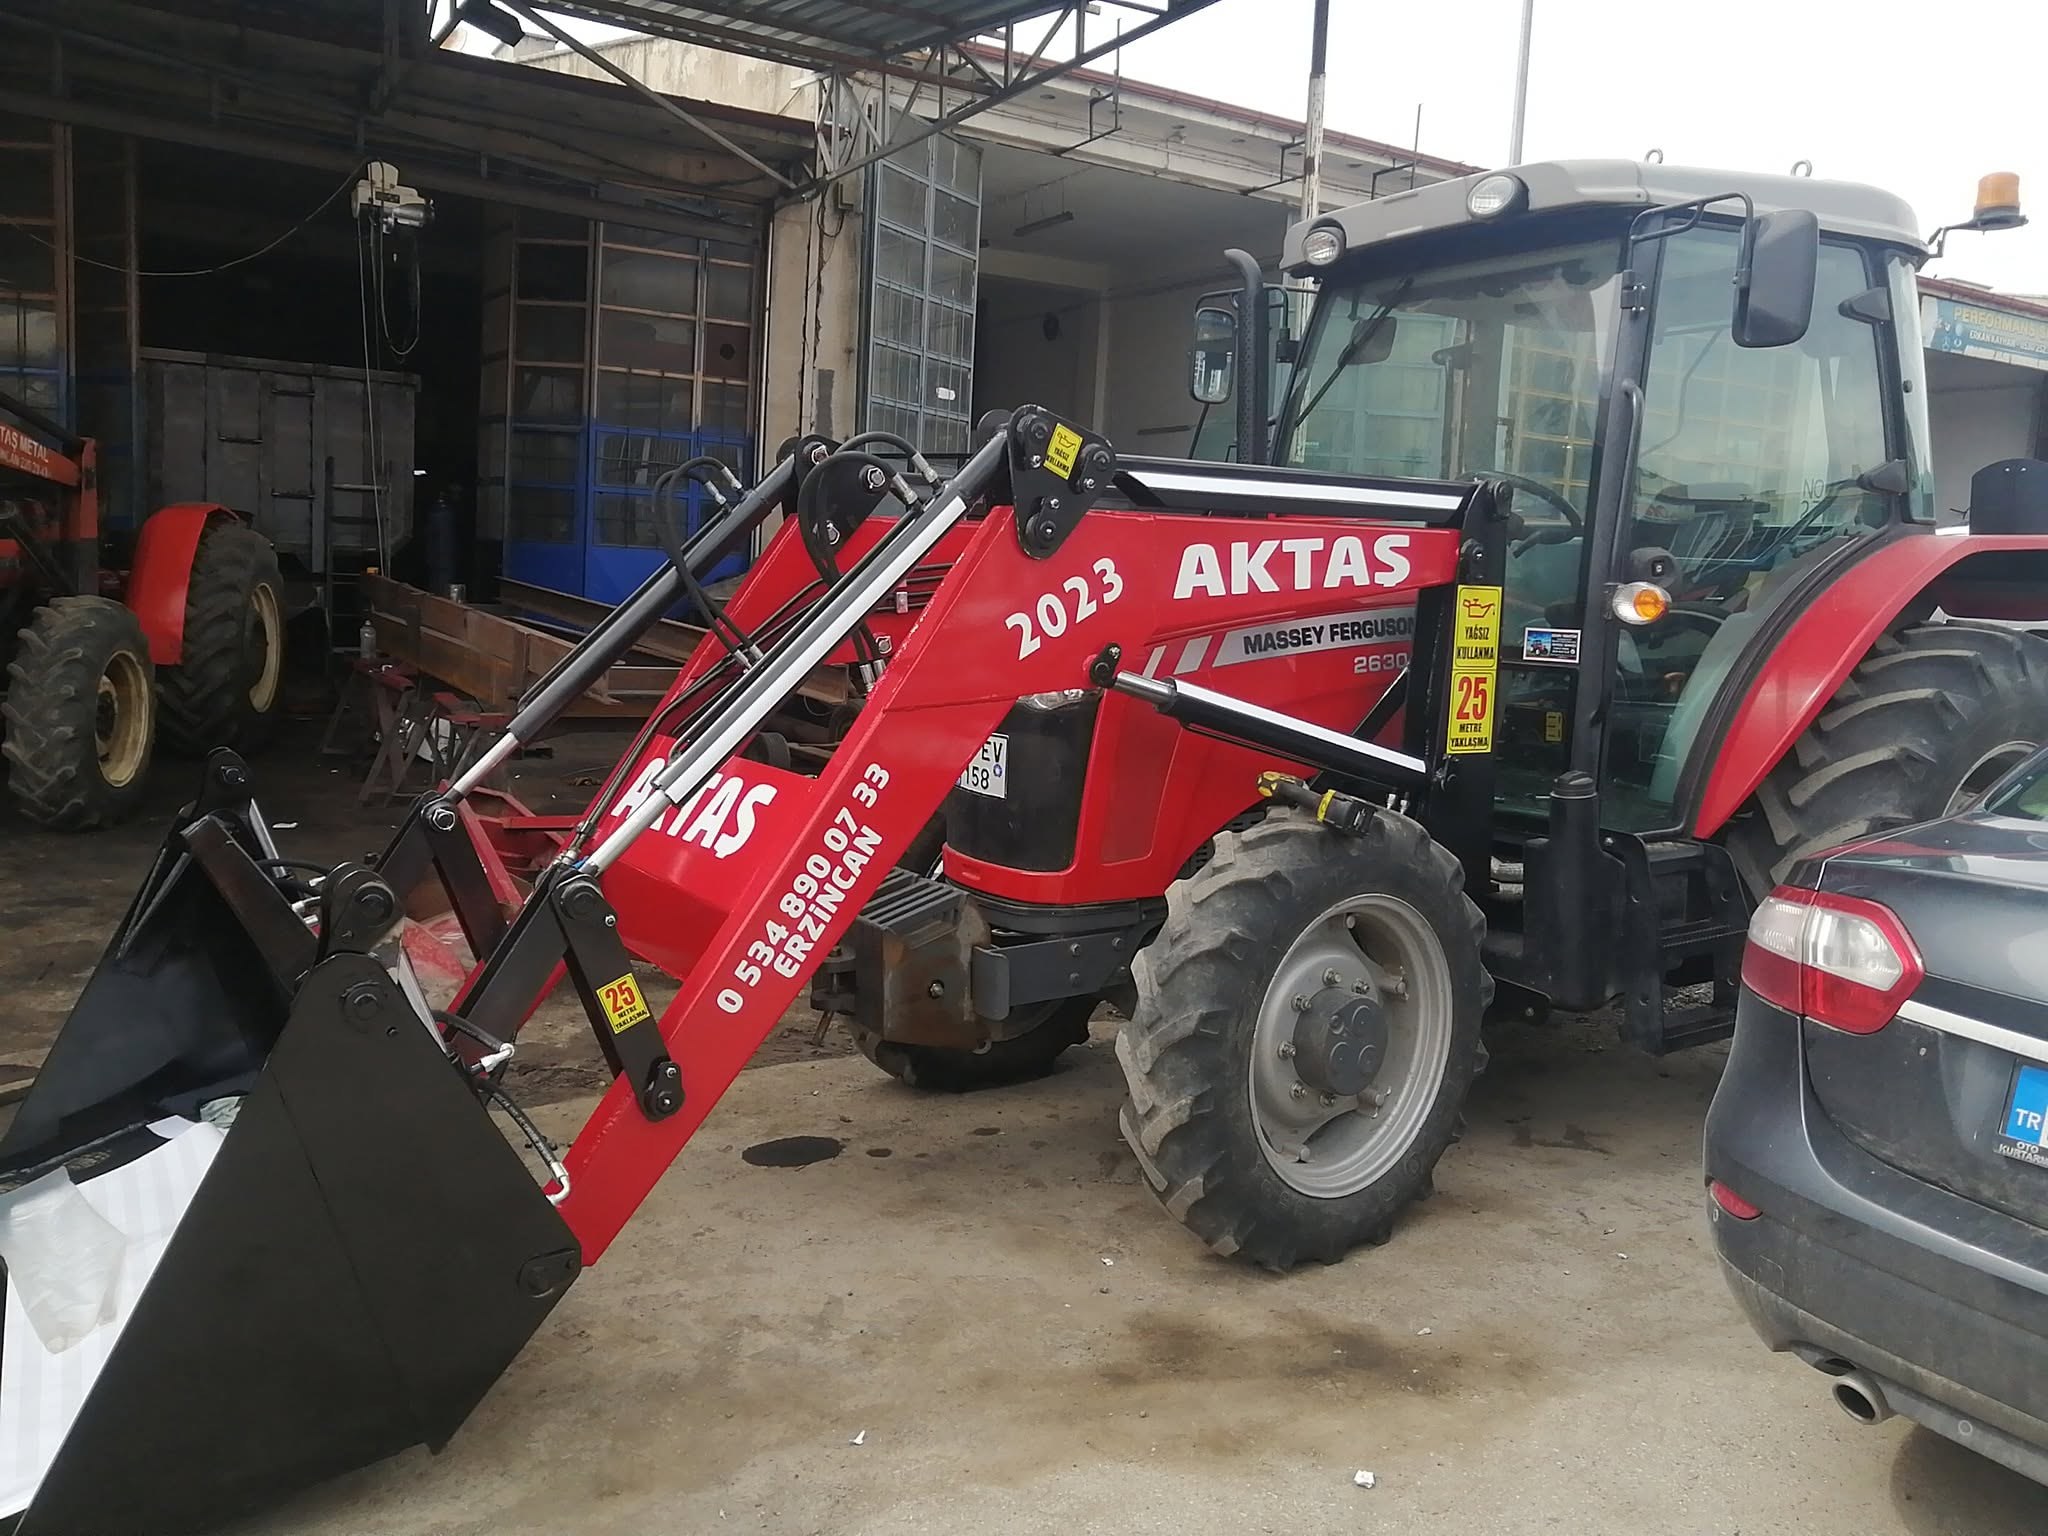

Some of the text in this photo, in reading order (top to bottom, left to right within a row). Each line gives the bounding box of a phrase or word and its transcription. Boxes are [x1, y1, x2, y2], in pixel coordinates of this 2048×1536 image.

[20, 434, 49, 464] METAL
[1173, 534, 1411, 600] AKTAŞ
[1004, 557, 1124, 661] 2023
[1243, 625, 1324, 655] MASSEY
[1457, 646, 1494, 660] KULLANMA
[1354, 652, 1408, 674] 2630
[1456, 676, 1487, 720] 25
[1459, 722, 1482, 733] METRE
[610, 757, 778, 859] ATAŞ
[717, 763, 890, 1014] 0 534 890 07 33
[604, 980, 636, 1014] 25
[2016, 1107, 2042, 1131] TR
[2016, 1141, 2039, 1154] OTO
